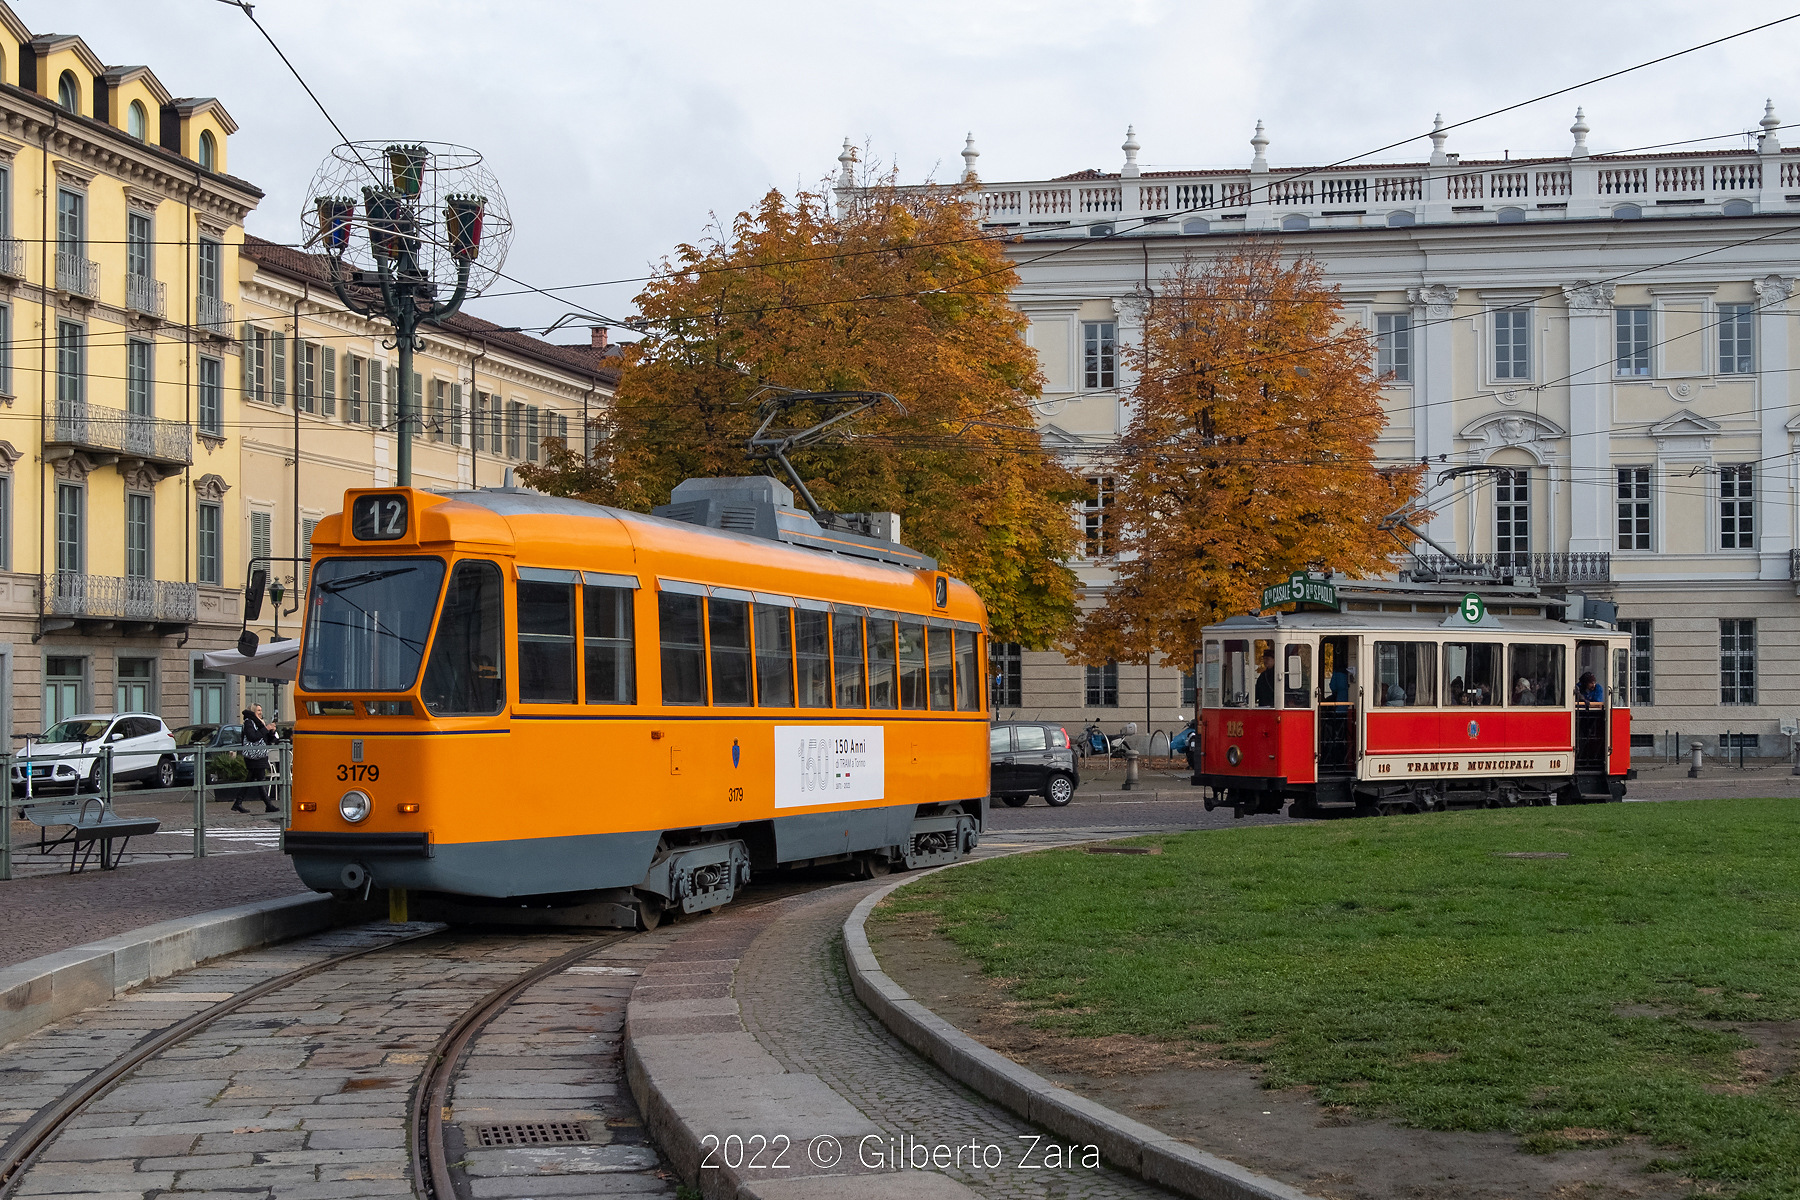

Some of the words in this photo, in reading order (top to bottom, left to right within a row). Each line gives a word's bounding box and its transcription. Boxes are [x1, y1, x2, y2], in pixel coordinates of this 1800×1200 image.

[369, 500, 401, 535] 12
[1273, 584, 1291, 603] CASALE
[1292, 576, 1305, 599] 5
[1465, 598, 1479, 621] 5
[1226, 720, 1244, 738] 116
[835, 738, 849, 754] 150
[850, 738, 866, 754] Anni
[336, 764, 380, 782] 3179
[1378, 763, 1391, 773] 116
[1407, 761, 1459, 772] TRAMVIE
[1467, 759, 1534, 771] MUNICIPALI
[1549, 759, 1561, 769] 116
[728, 787, 743, 802] 3179
